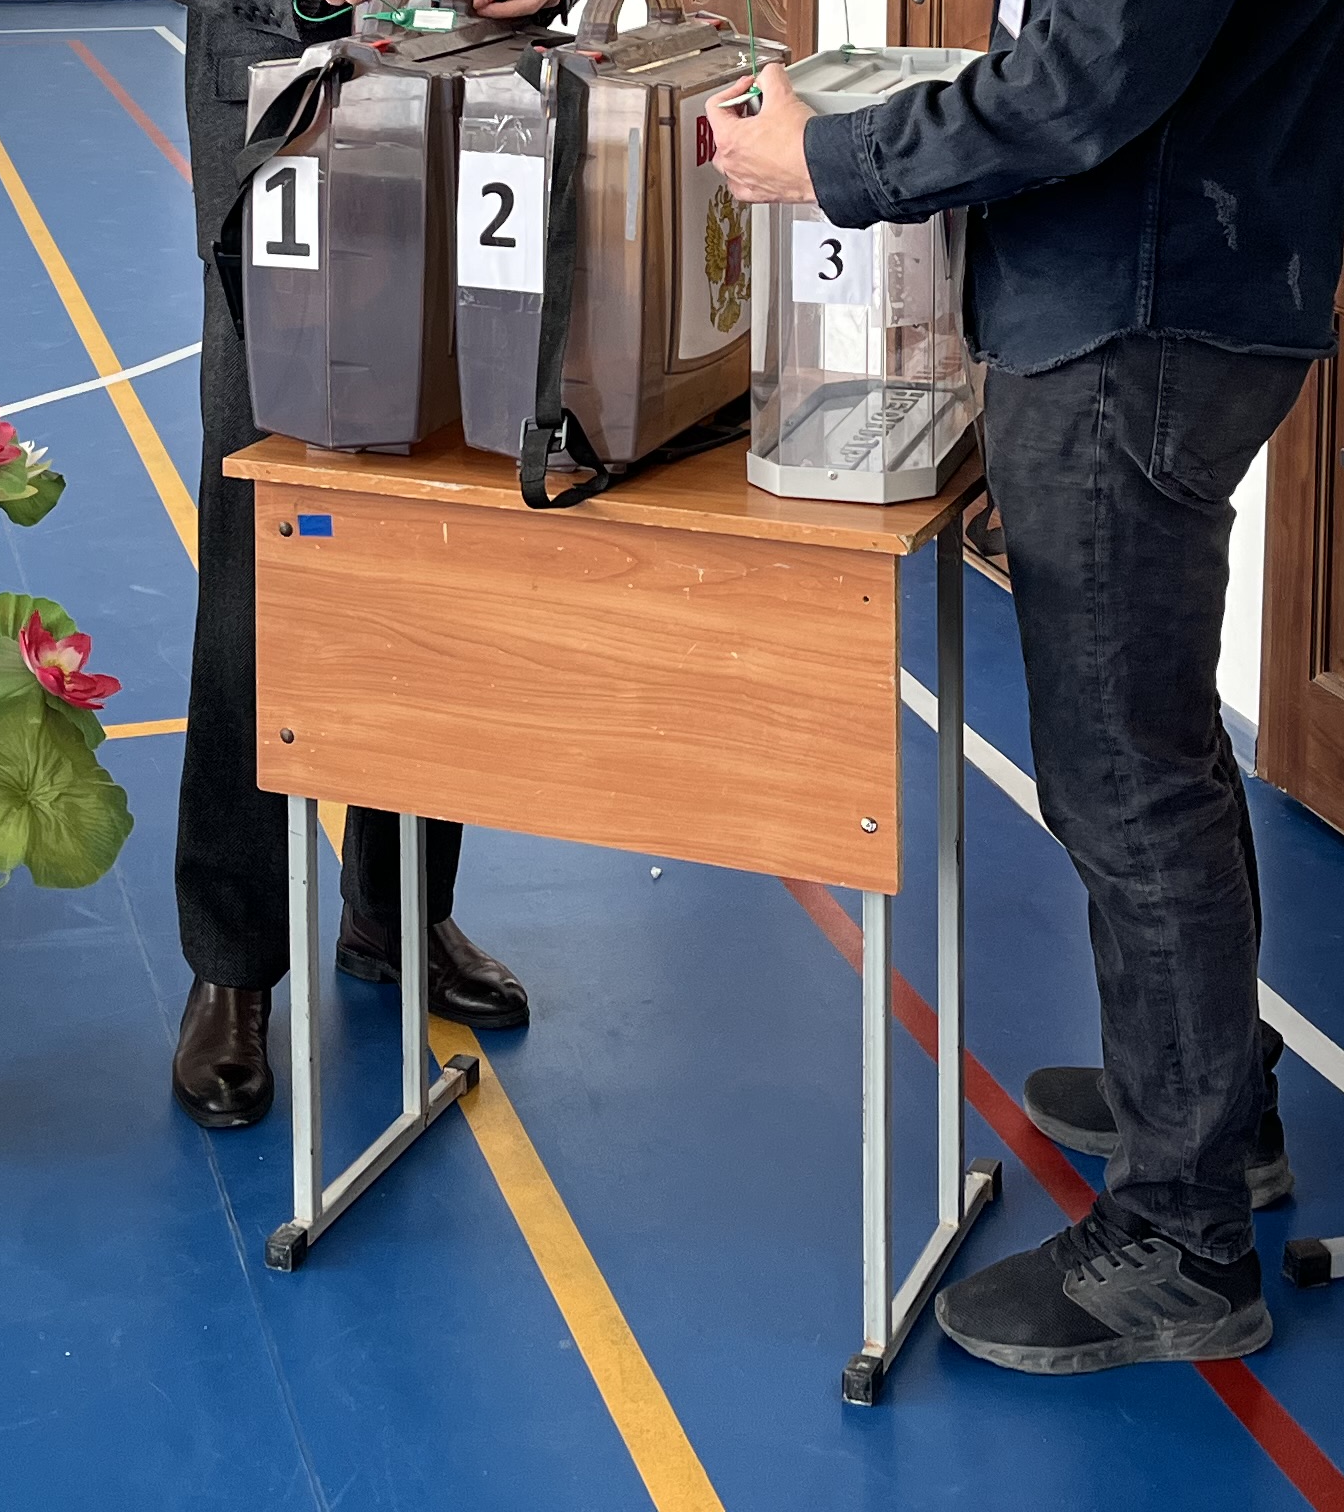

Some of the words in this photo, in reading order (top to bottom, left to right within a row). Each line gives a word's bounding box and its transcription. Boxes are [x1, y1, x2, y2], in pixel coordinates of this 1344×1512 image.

[265, 167, 310, 257] 1
[479, 181, 516, 248] 2
[818, 238, 844, 281] 3
